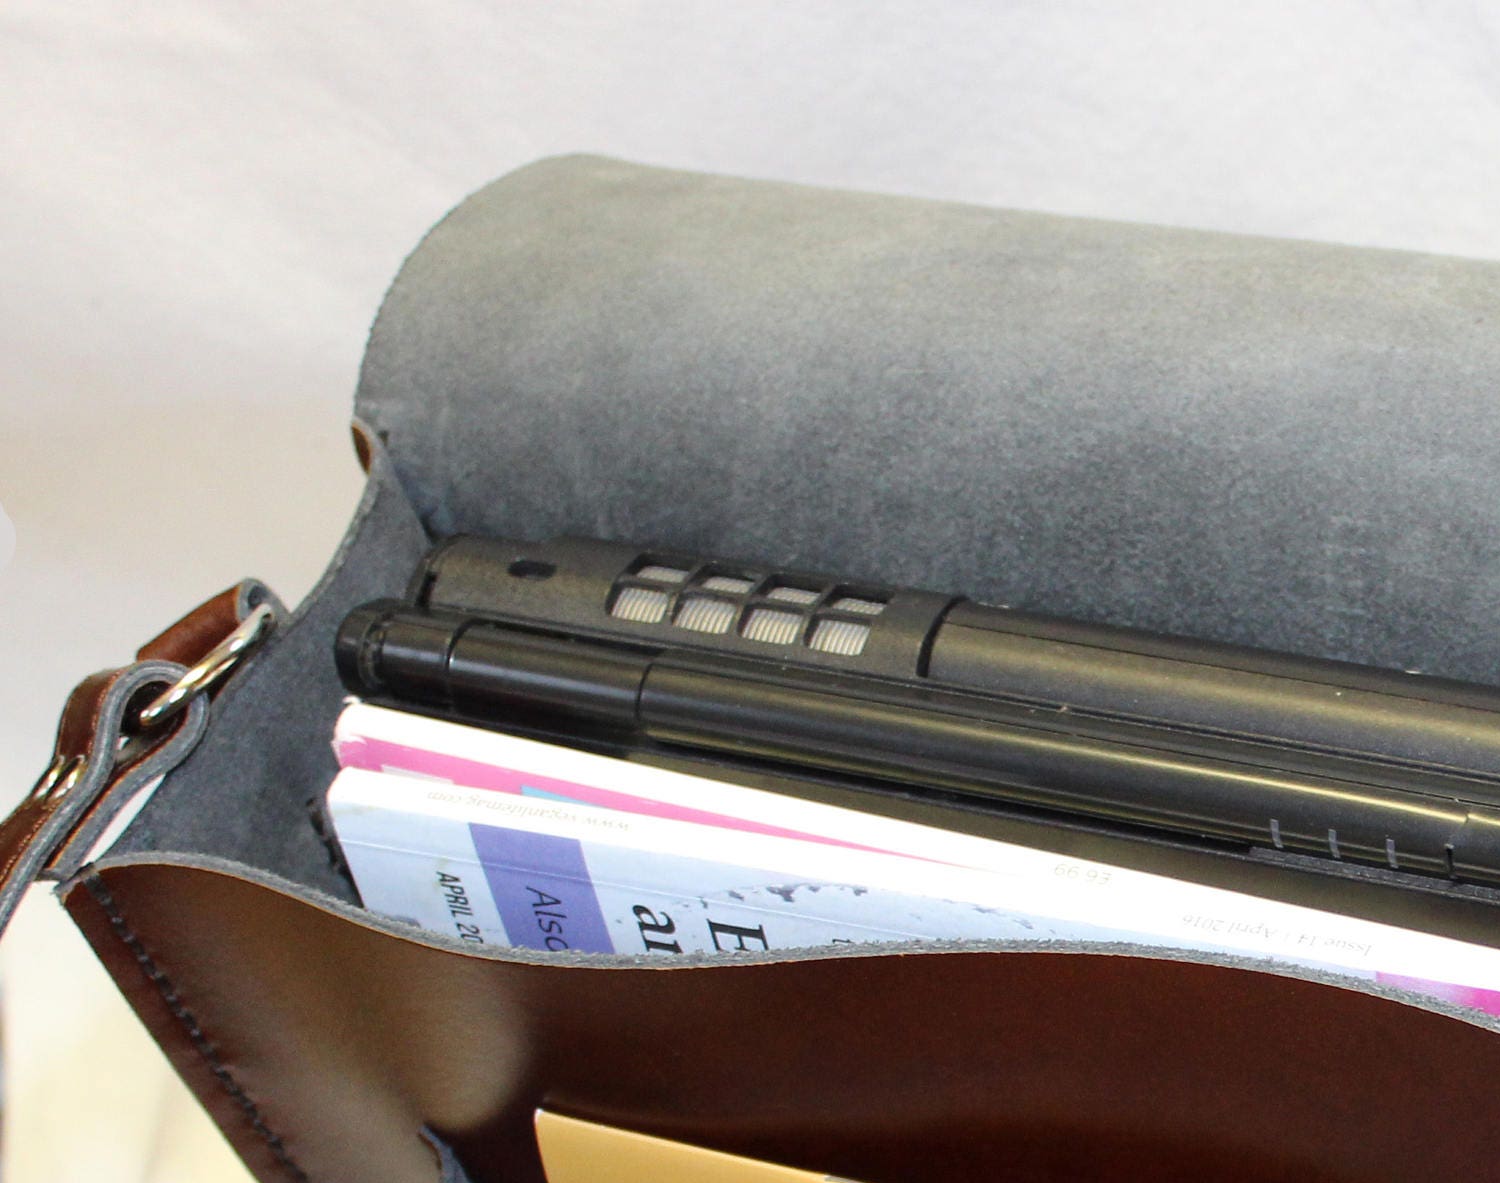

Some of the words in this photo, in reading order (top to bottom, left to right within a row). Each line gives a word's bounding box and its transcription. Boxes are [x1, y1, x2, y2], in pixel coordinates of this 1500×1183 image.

[435, 870, 476, 923] APRIL
[525, 884, 571, 952] Also
[1181, 914, 1220, 933] 2016
[1228, 919, 1276, 940] April
[1322, 936, 1373, 960] Issue
